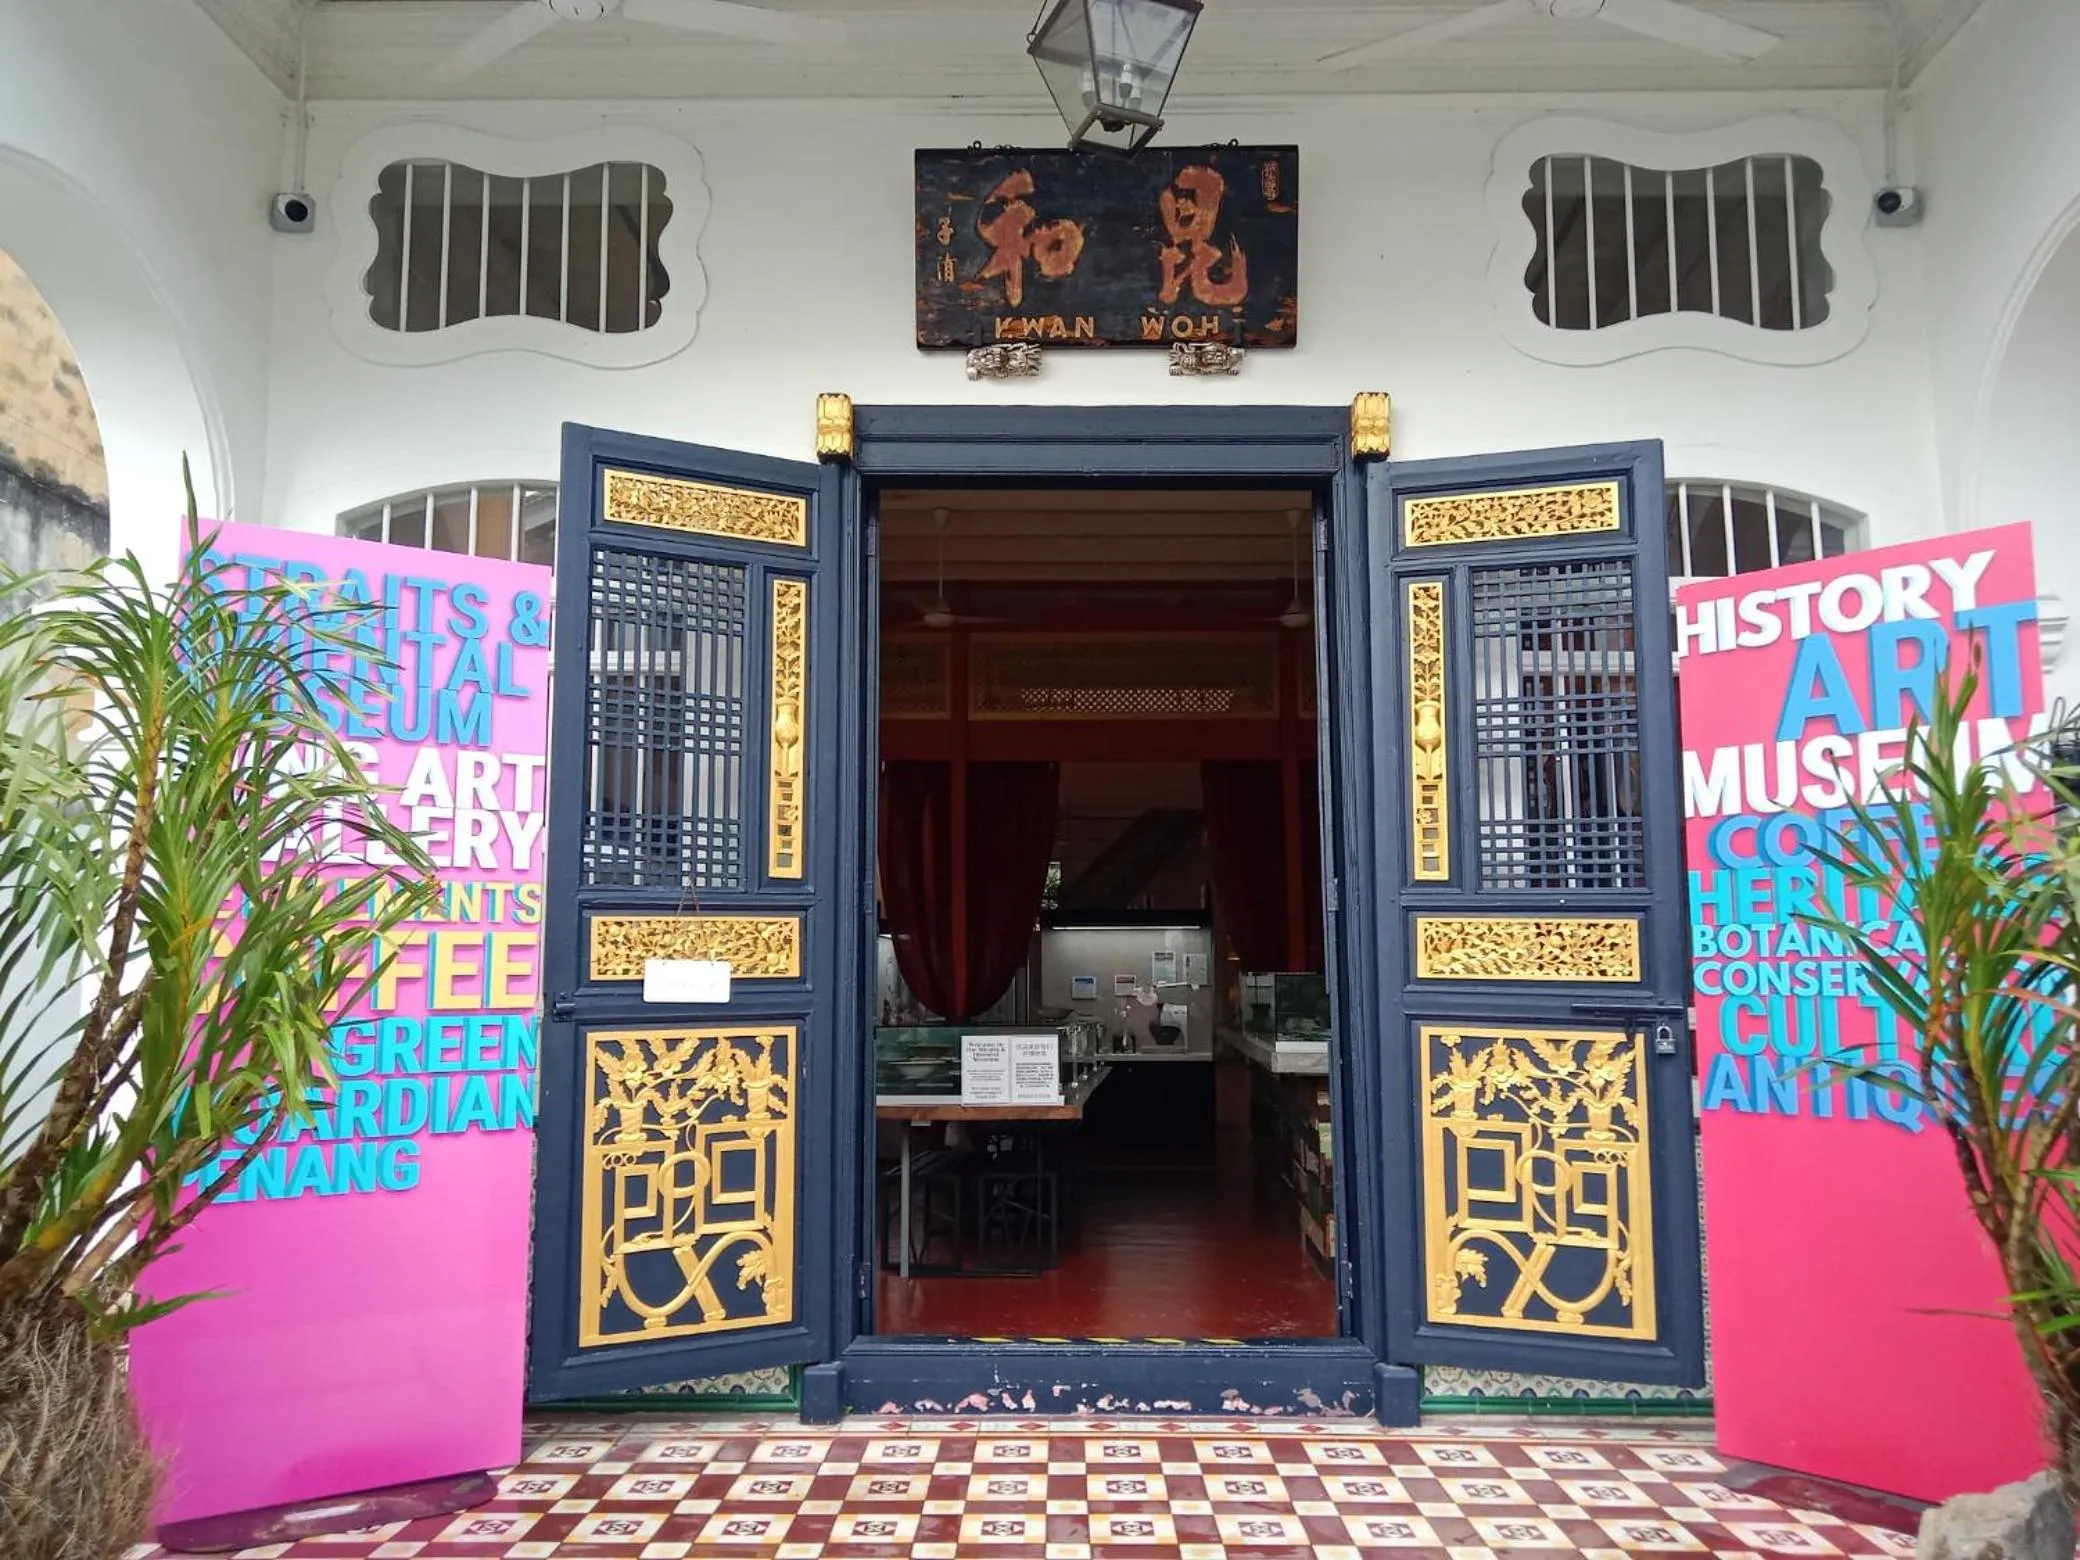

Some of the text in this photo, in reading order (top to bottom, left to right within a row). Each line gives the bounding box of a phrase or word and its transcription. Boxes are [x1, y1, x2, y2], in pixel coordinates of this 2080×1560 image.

[995, 315, 1221, 340] KWAN WOH
[510, 590, 549, 646] &
[1675, 549, 1996, 658] HISTORY
[1776, 600, 2040, 741] ART
[401, 745, 546, 813] ART
[255, 798, 545, 871] ALLERY
[327, 1015, 538, 1077] GREEN
[182, 1139, 421, 1204] ENANG
